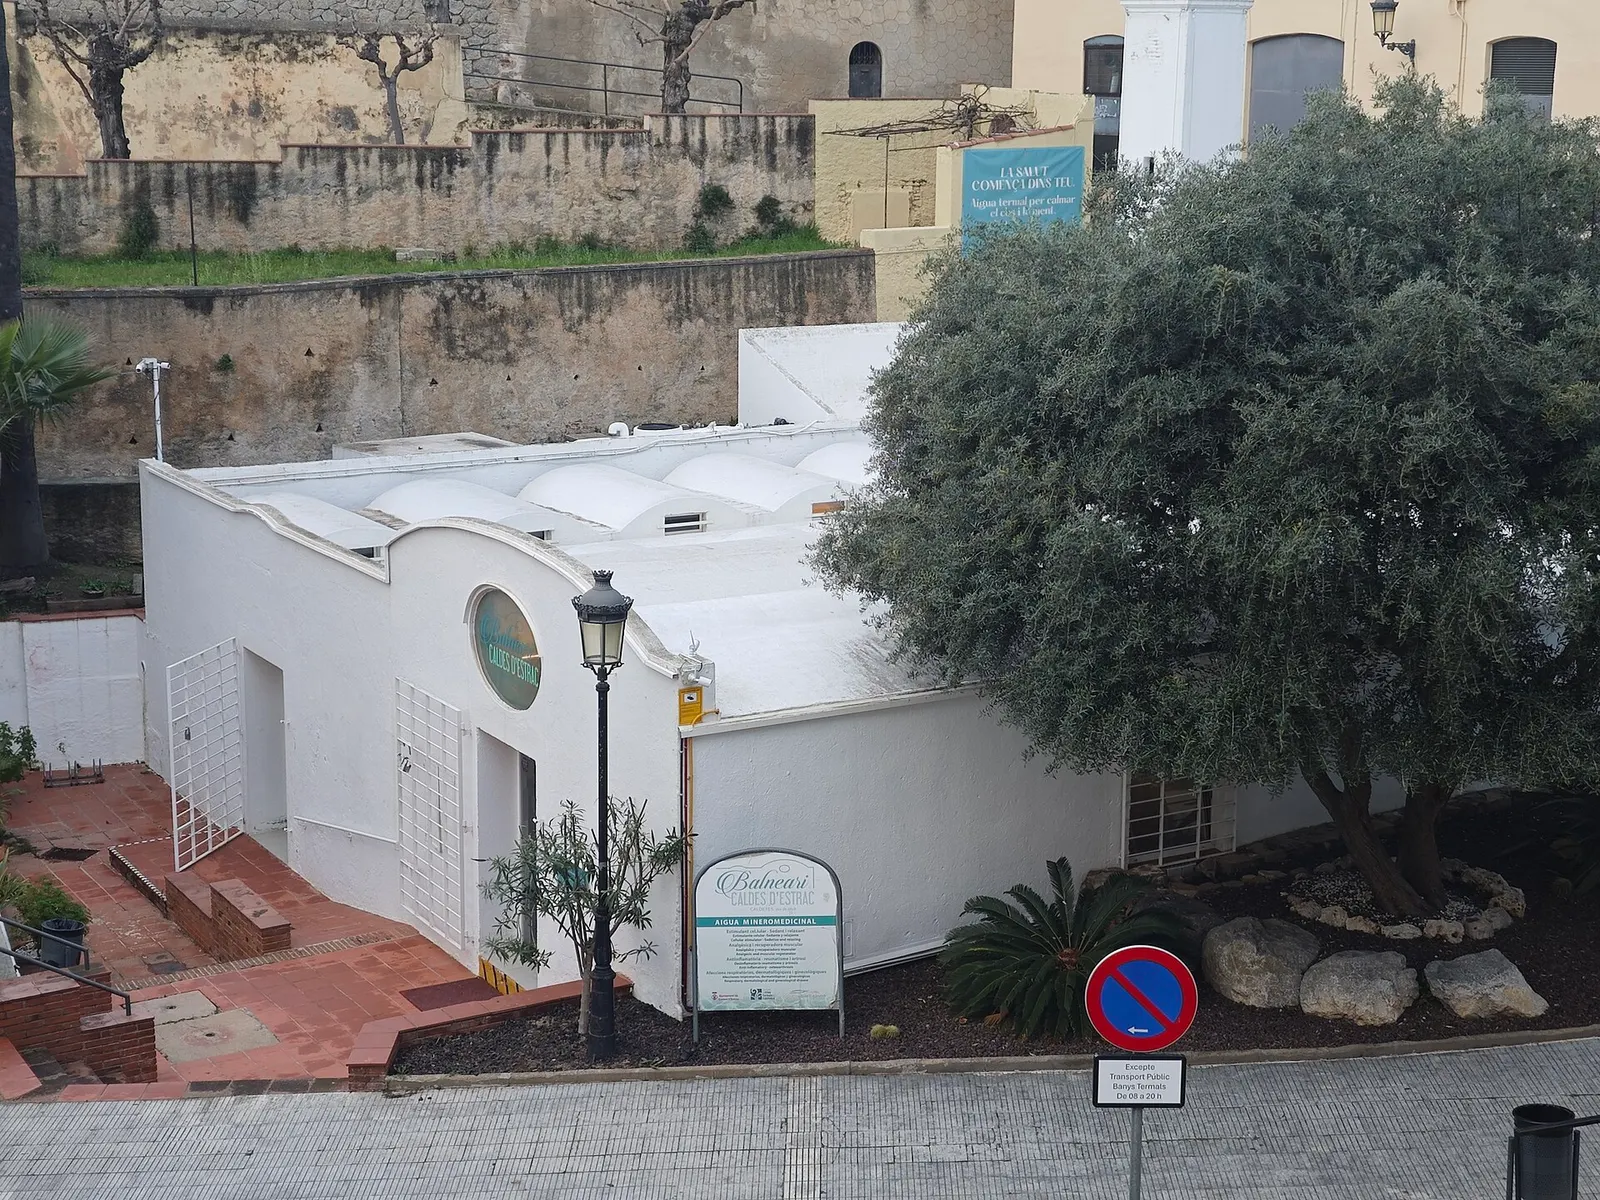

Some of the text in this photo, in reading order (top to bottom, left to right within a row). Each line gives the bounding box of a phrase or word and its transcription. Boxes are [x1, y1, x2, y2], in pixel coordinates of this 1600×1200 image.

[1000, 166, 1049, 178] LA SALUT
[1028, 178, 1052, 189] DINS
[971, 194, 1076, 210] Aigua termal per calmar
[990, 207, 999, 218] el
[488, 643, 539, 688] CALDES D'ESTRAC
[714, 870, 809, 898] Balneari
[731, 890, 815, 906] CALDES D'ESTRAC
[1146, 1072, 1170, 1080] Públic
